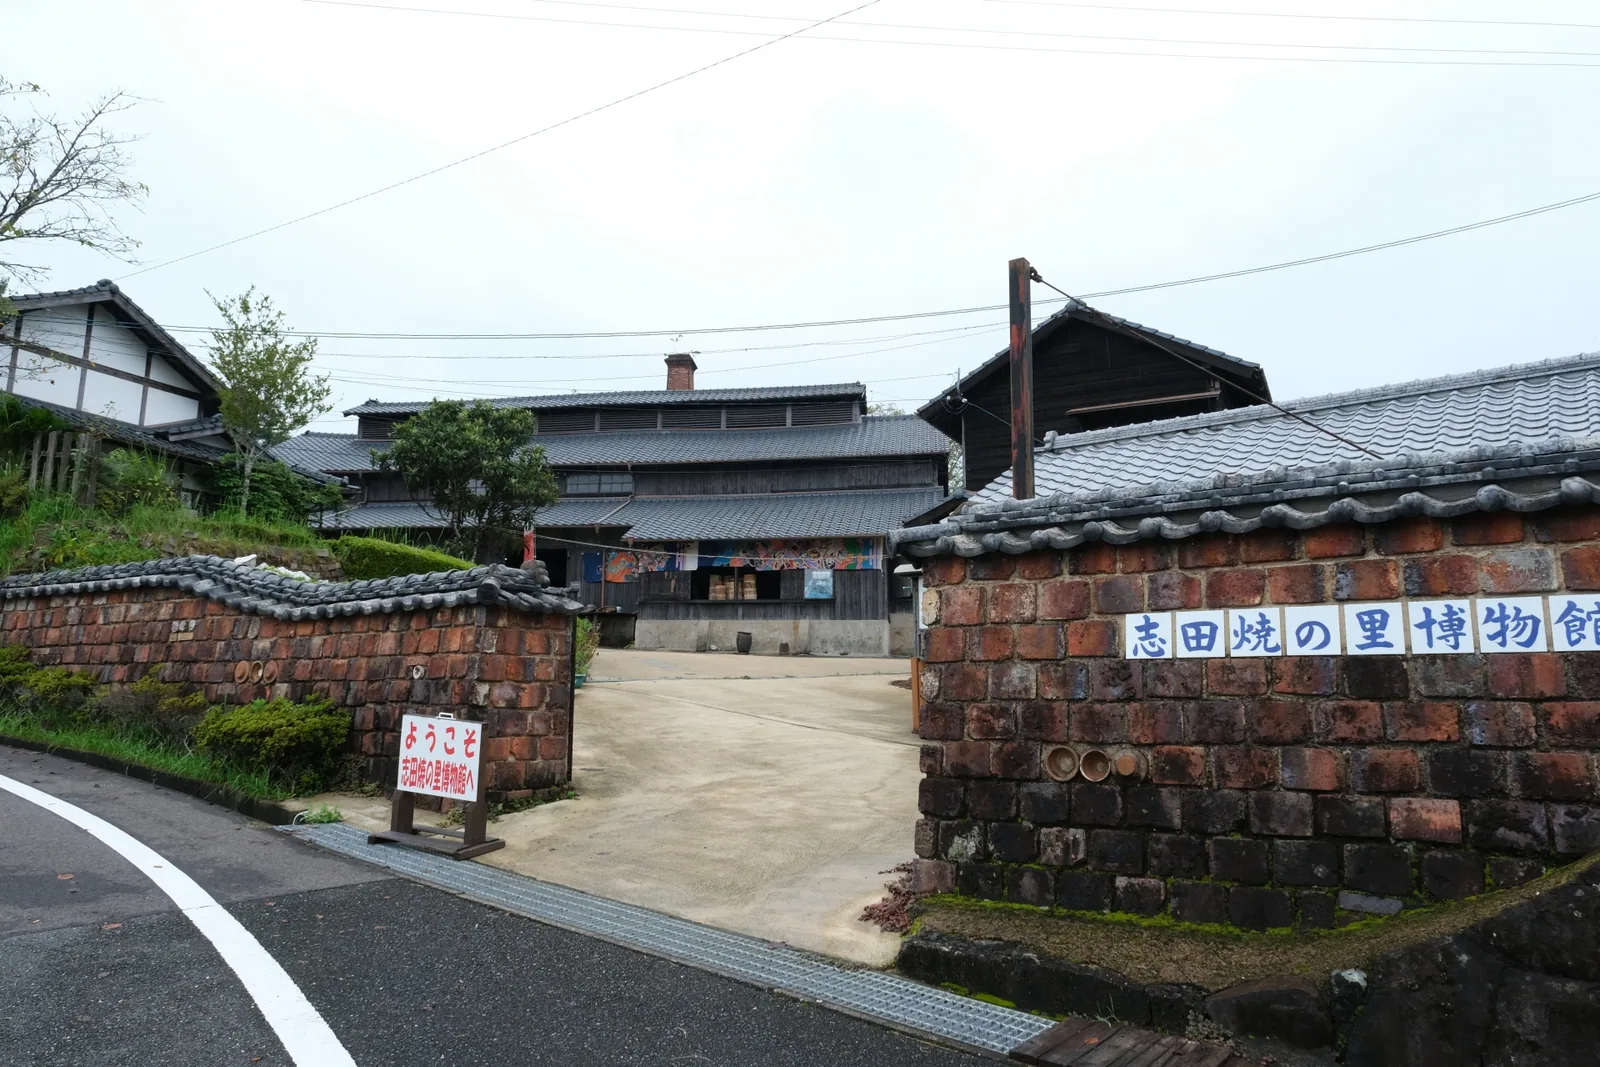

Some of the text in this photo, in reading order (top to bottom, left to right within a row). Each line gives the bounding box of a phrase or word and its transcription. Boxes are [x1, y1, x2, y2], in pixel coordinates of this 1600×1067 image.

[1133, 600, 1600, 658] 志田焼の里博物館
[405, 721, 476, 758] ようこそ
[401, 756, 474, 795] 志田焼の里博物館へ
